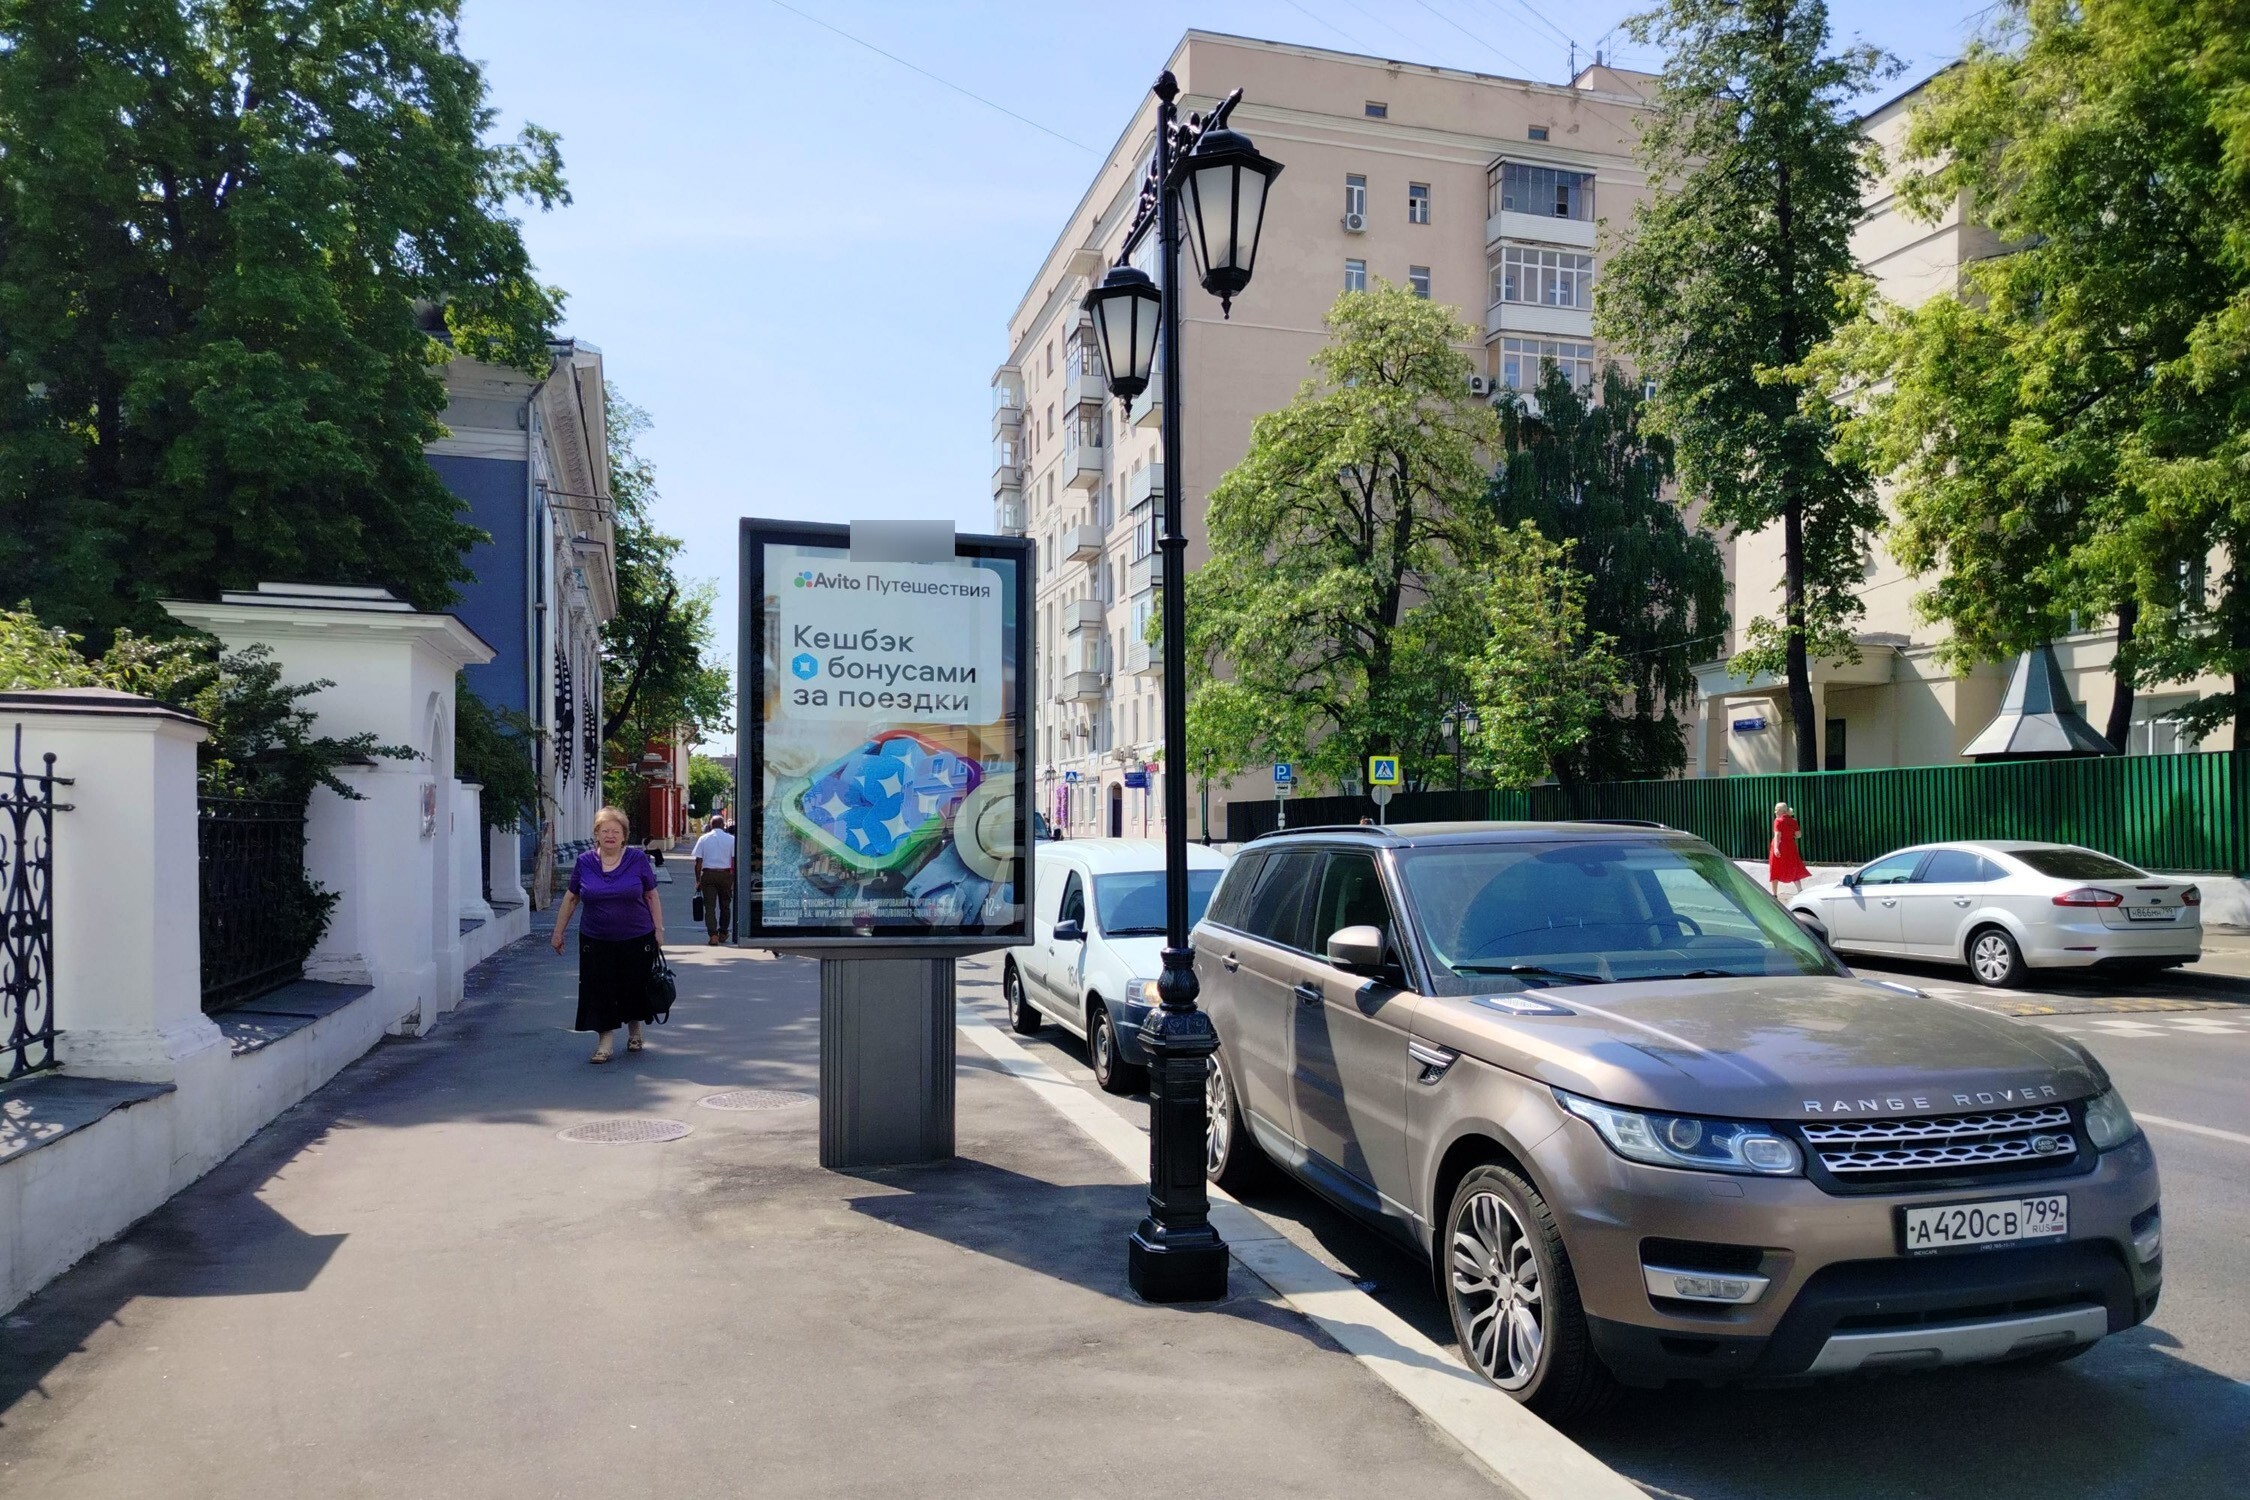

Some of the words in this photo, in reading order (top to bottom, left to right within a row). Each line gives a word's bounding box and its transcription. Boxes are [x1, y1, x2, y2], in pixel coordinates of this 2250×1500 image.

[813, 572, 861, 590] Avito
[866, 575, 991, 598] Путешествия
[794, 624, 914, 653] Кешбэк
[828, 656, 976, 687] бонусами
[793, 688, 828, 706] за
[839, 690, 969, 713] поездки
[985, 897, 1001, 917] 12+
[1803, 1097, 1931, 1113] RANGE
[1952, 1085, 2057, 1106] ROVER
[1916, 1210, 2018, 1244] А420СВ
[2023, 1200, 2059, 1225] 799
[2032, 1224, 2051, 1233] RUS
